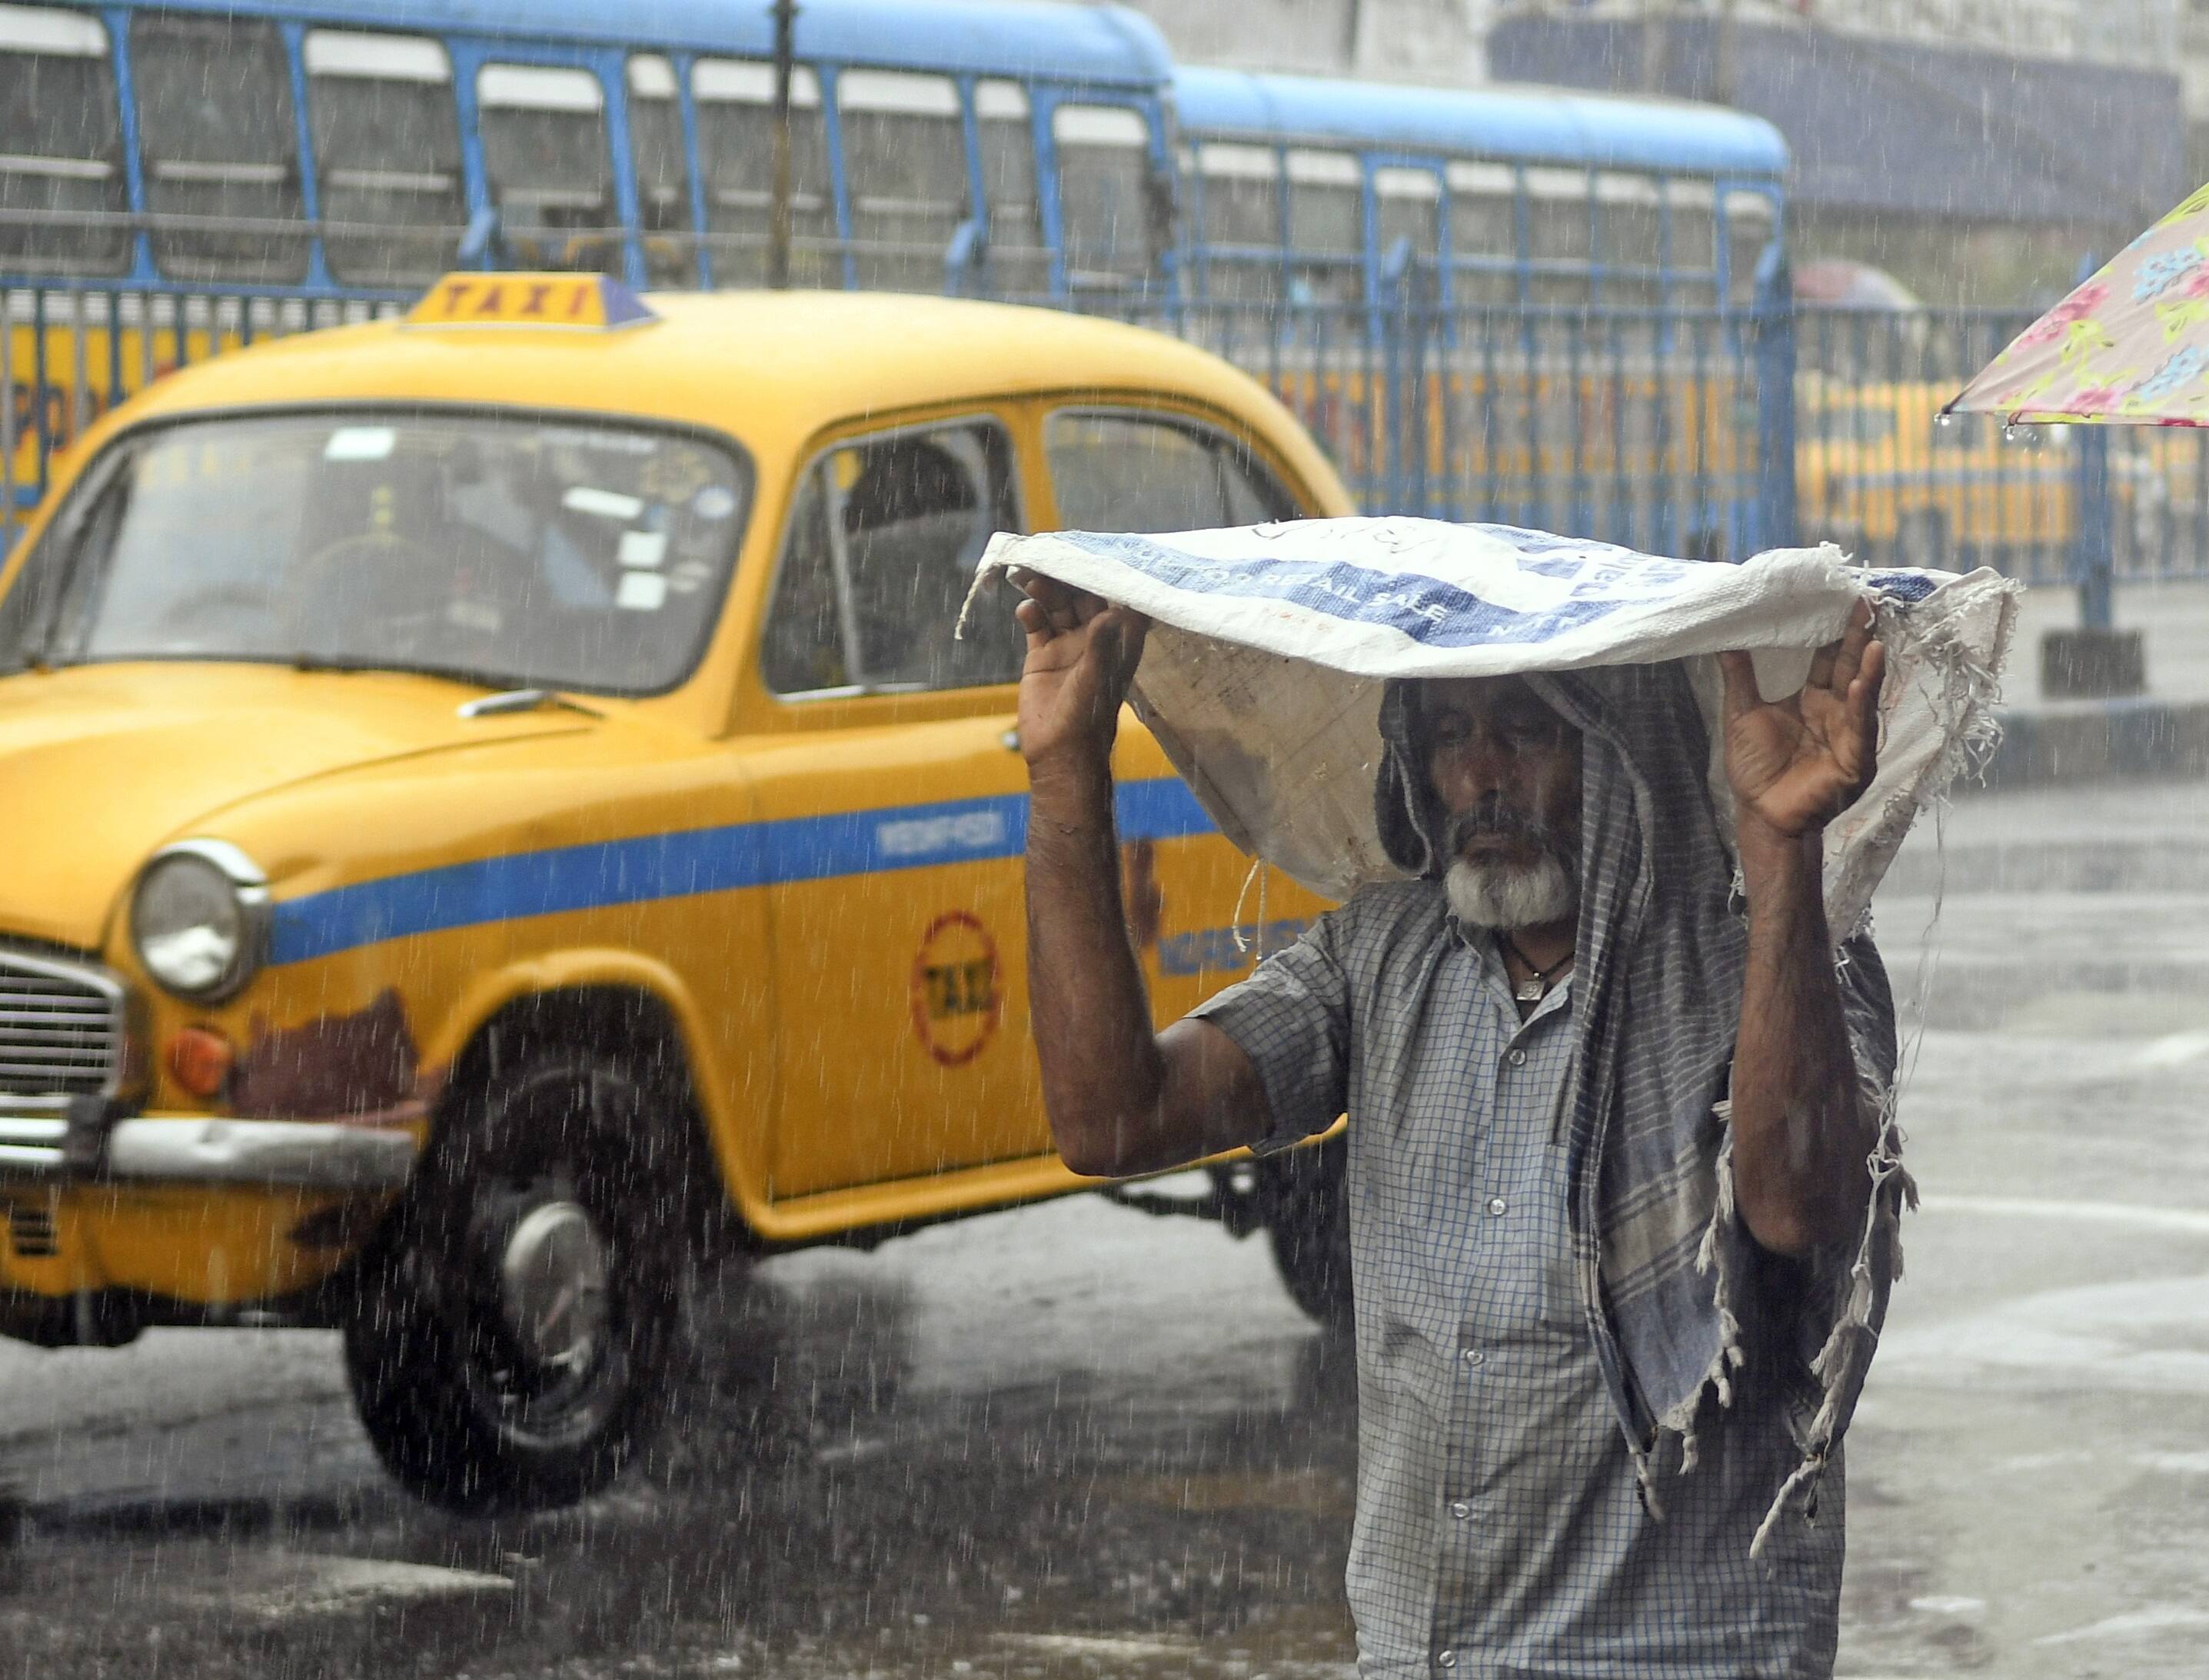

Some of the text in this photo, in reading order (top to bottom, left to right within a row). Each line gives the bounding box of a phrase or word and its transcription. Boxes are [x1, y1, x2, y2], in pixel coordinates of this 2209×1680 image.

[443, 282, 590, 317] TAXI
[1366, 590, 1449, 624] SALE
[922, 959, 996, 1020] TAXI
